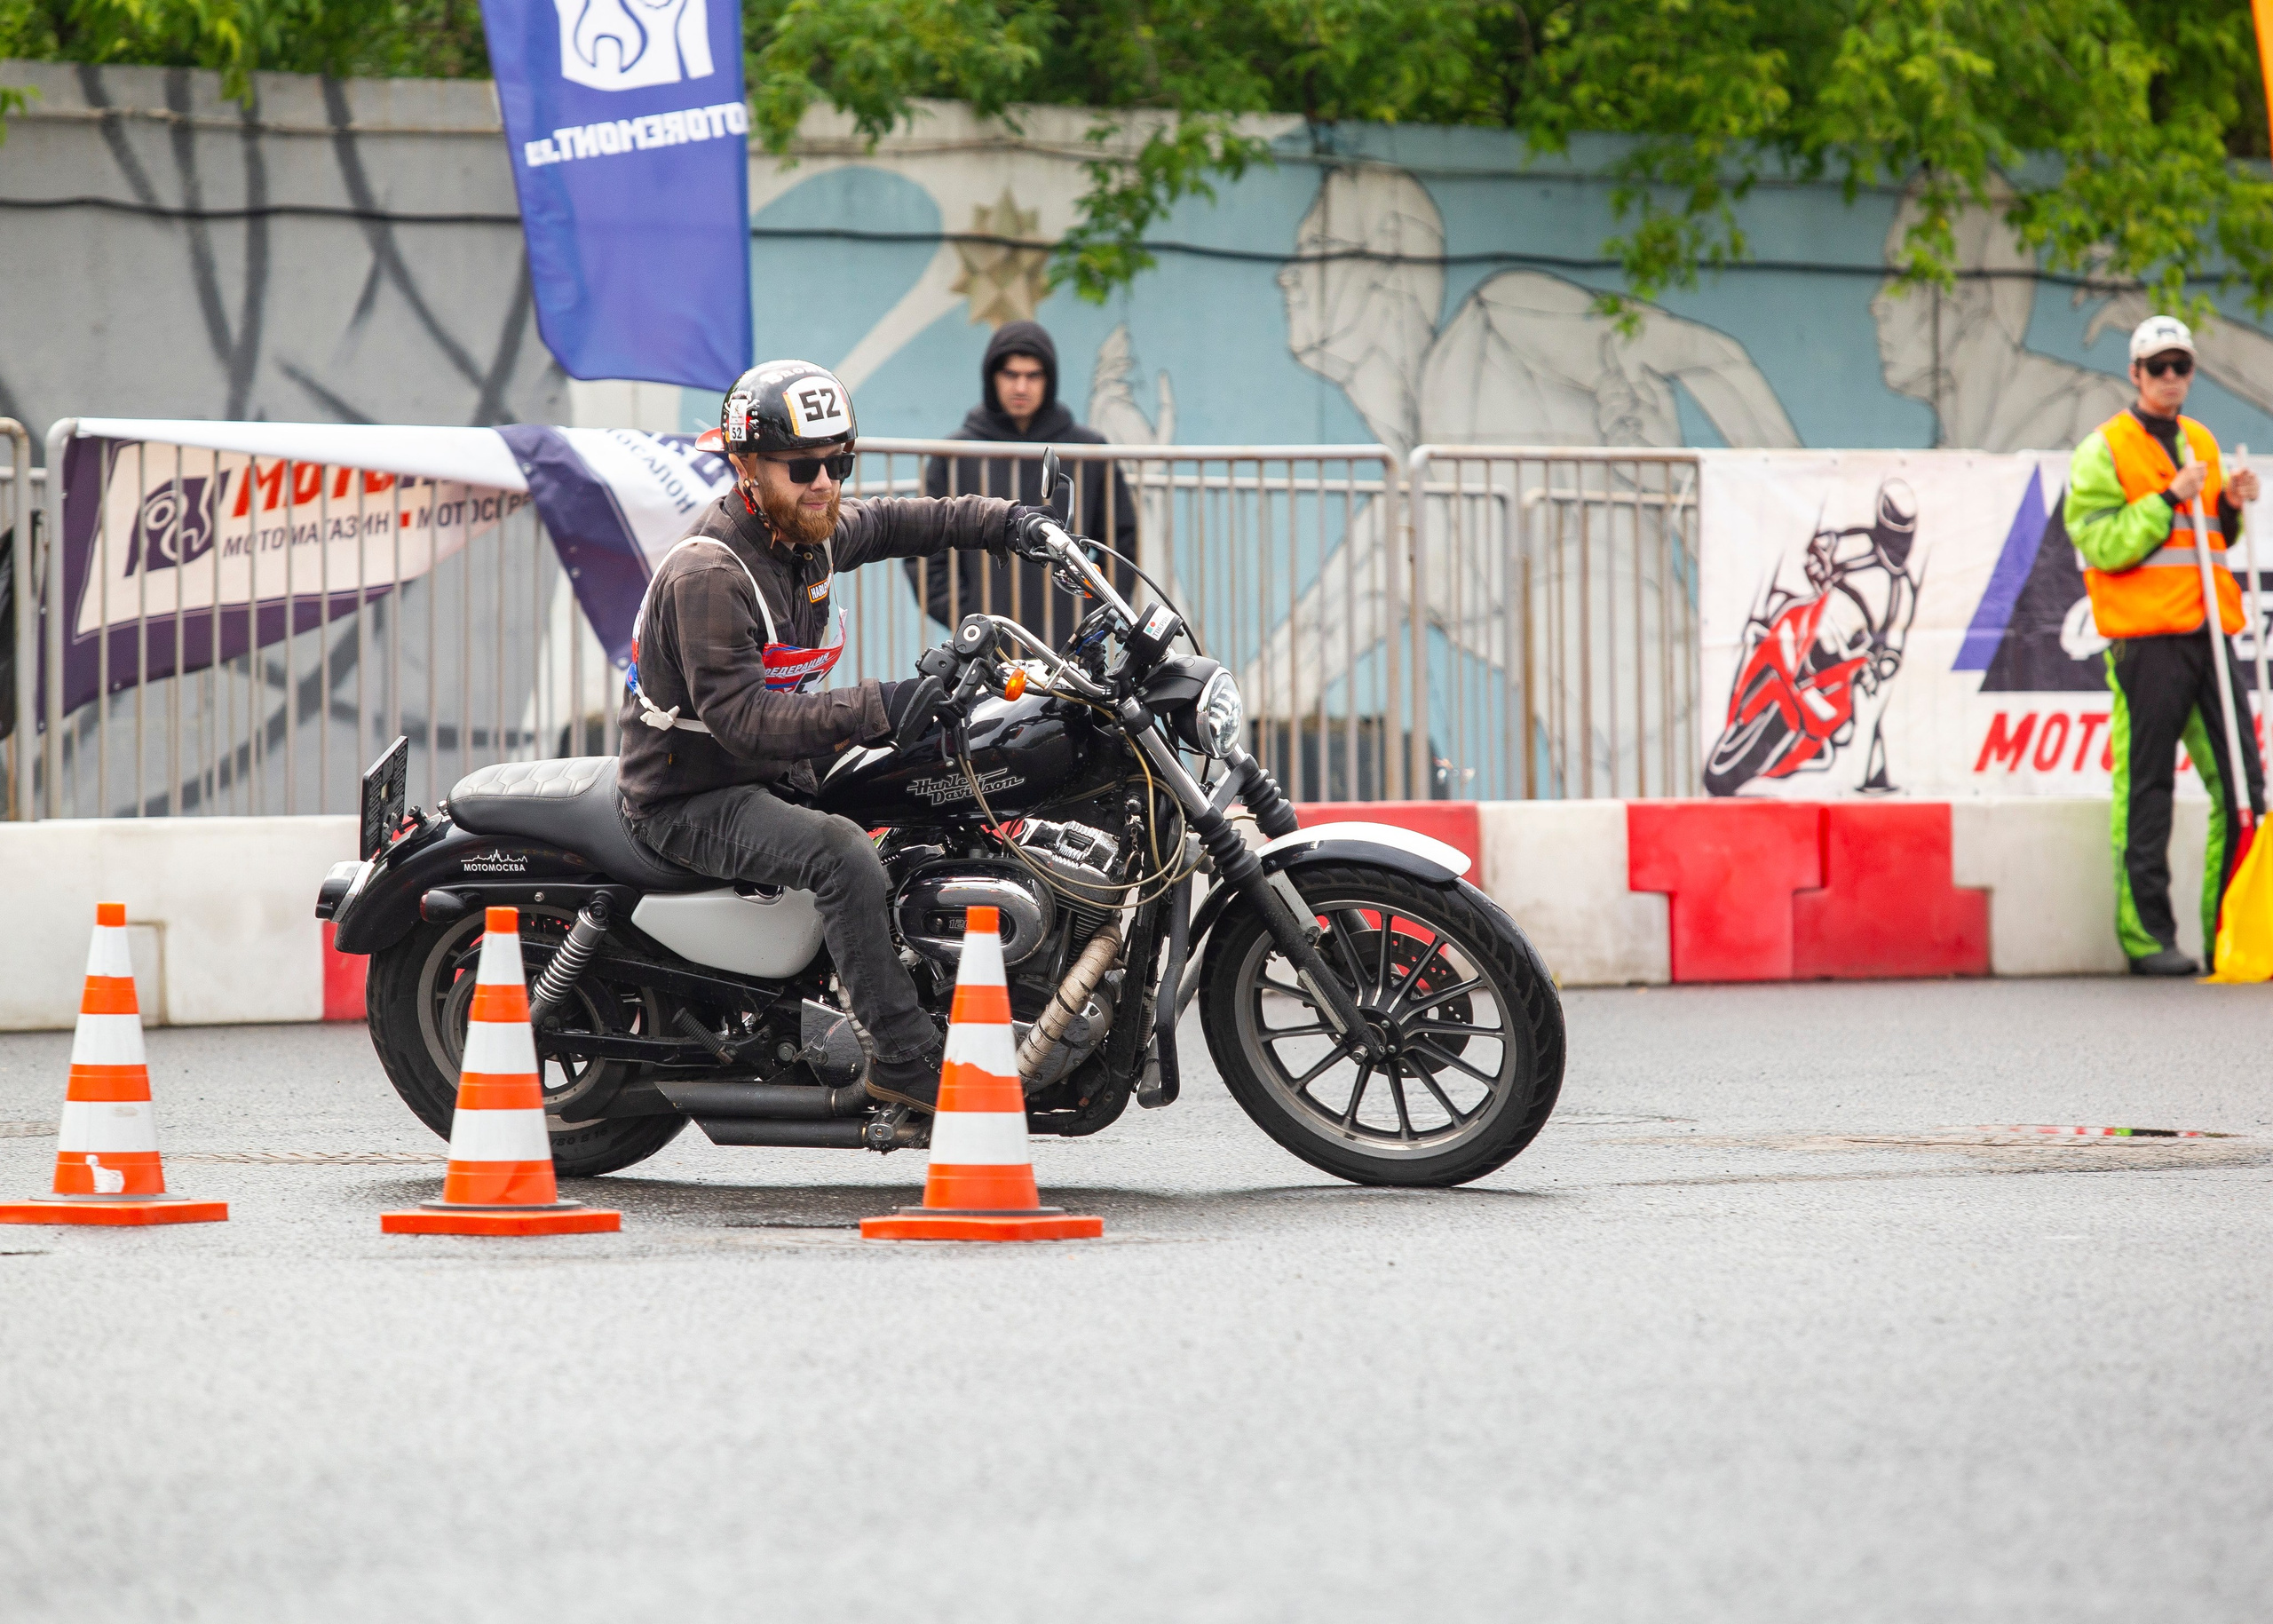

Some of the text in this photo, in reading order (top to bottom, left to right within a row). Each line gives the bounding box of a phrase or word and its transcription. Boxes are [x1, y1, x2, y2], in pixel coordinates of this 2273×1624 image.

[799, 388, 841, 422] 52
[732, 427, 742, 440] 52
[463, 863, 526, 872] МОТОМОСКВА
